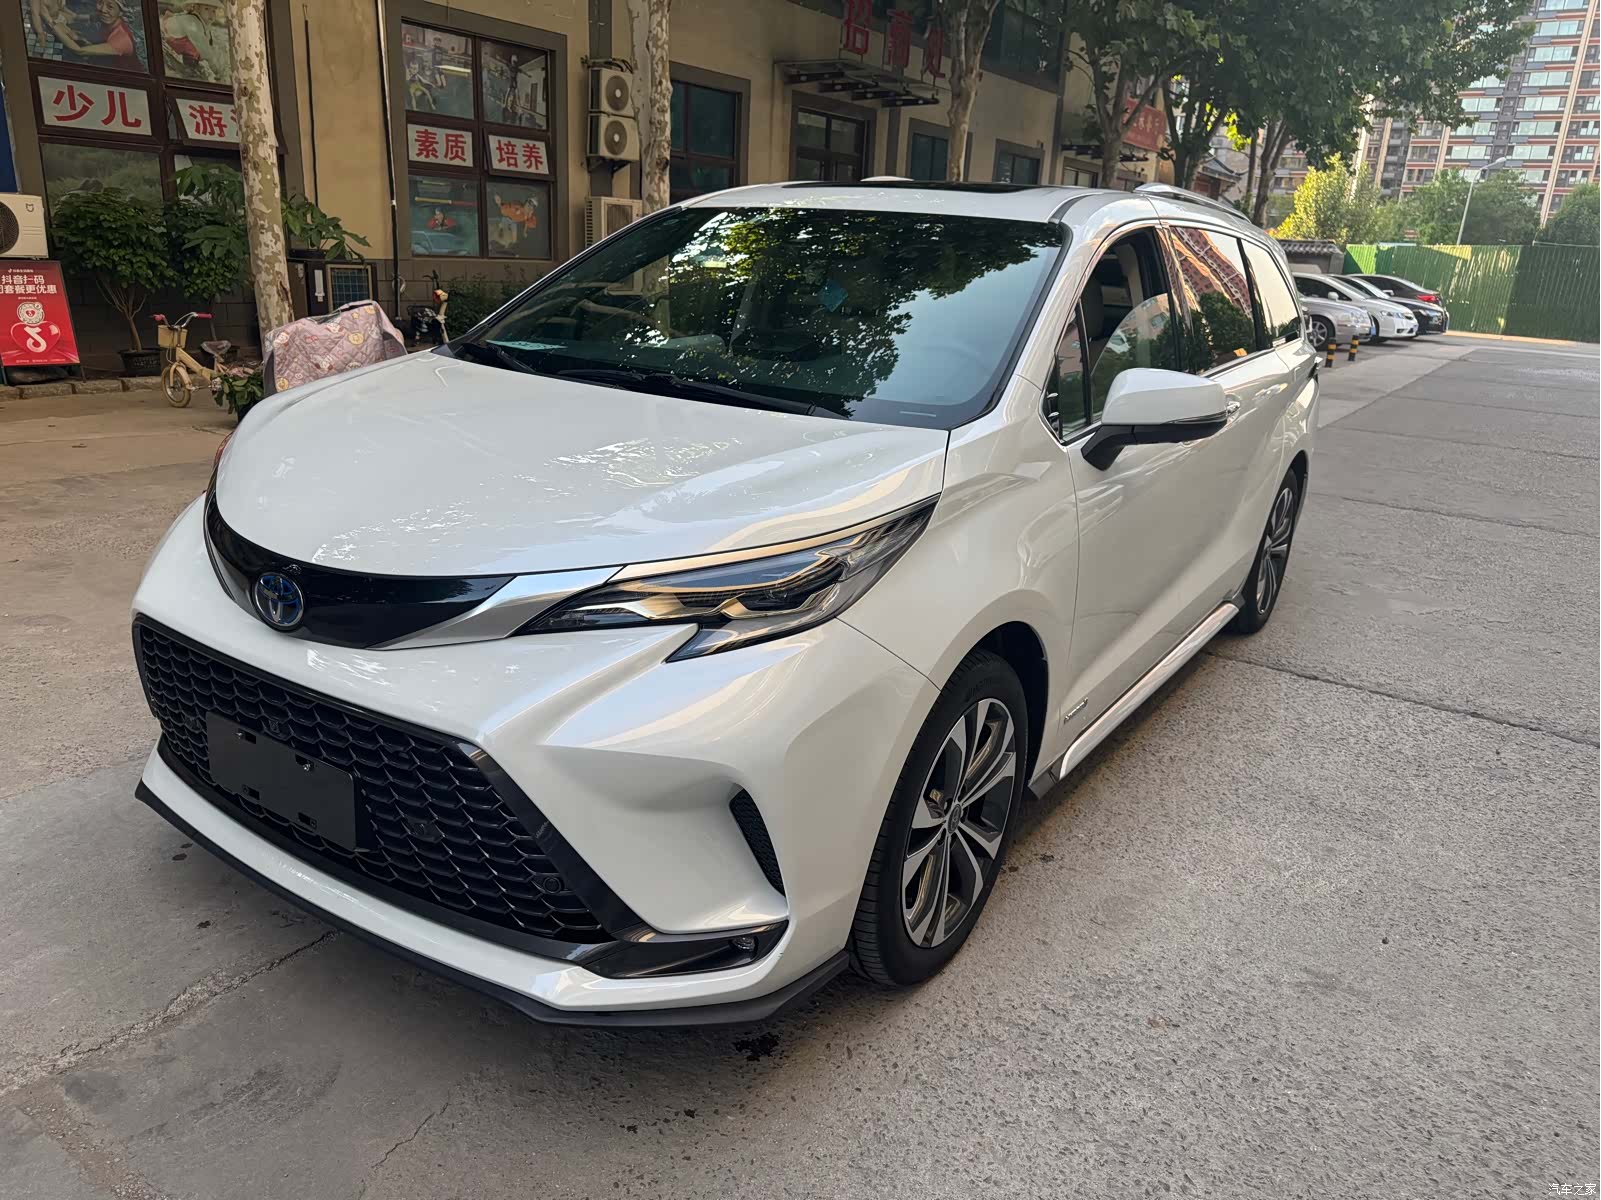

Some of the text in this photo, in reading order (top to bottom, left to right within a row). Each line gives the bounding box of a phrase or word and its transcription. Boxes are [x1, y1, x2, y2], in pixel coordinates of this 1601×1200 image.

[53, 85, 141, 128] 少儿
[188, 104, 240, 138] 游
[415, 129, 467, 162] 素质
[496, 140, 544, 170] 培养
[1, 274, 45, 285] 抖音扫码
